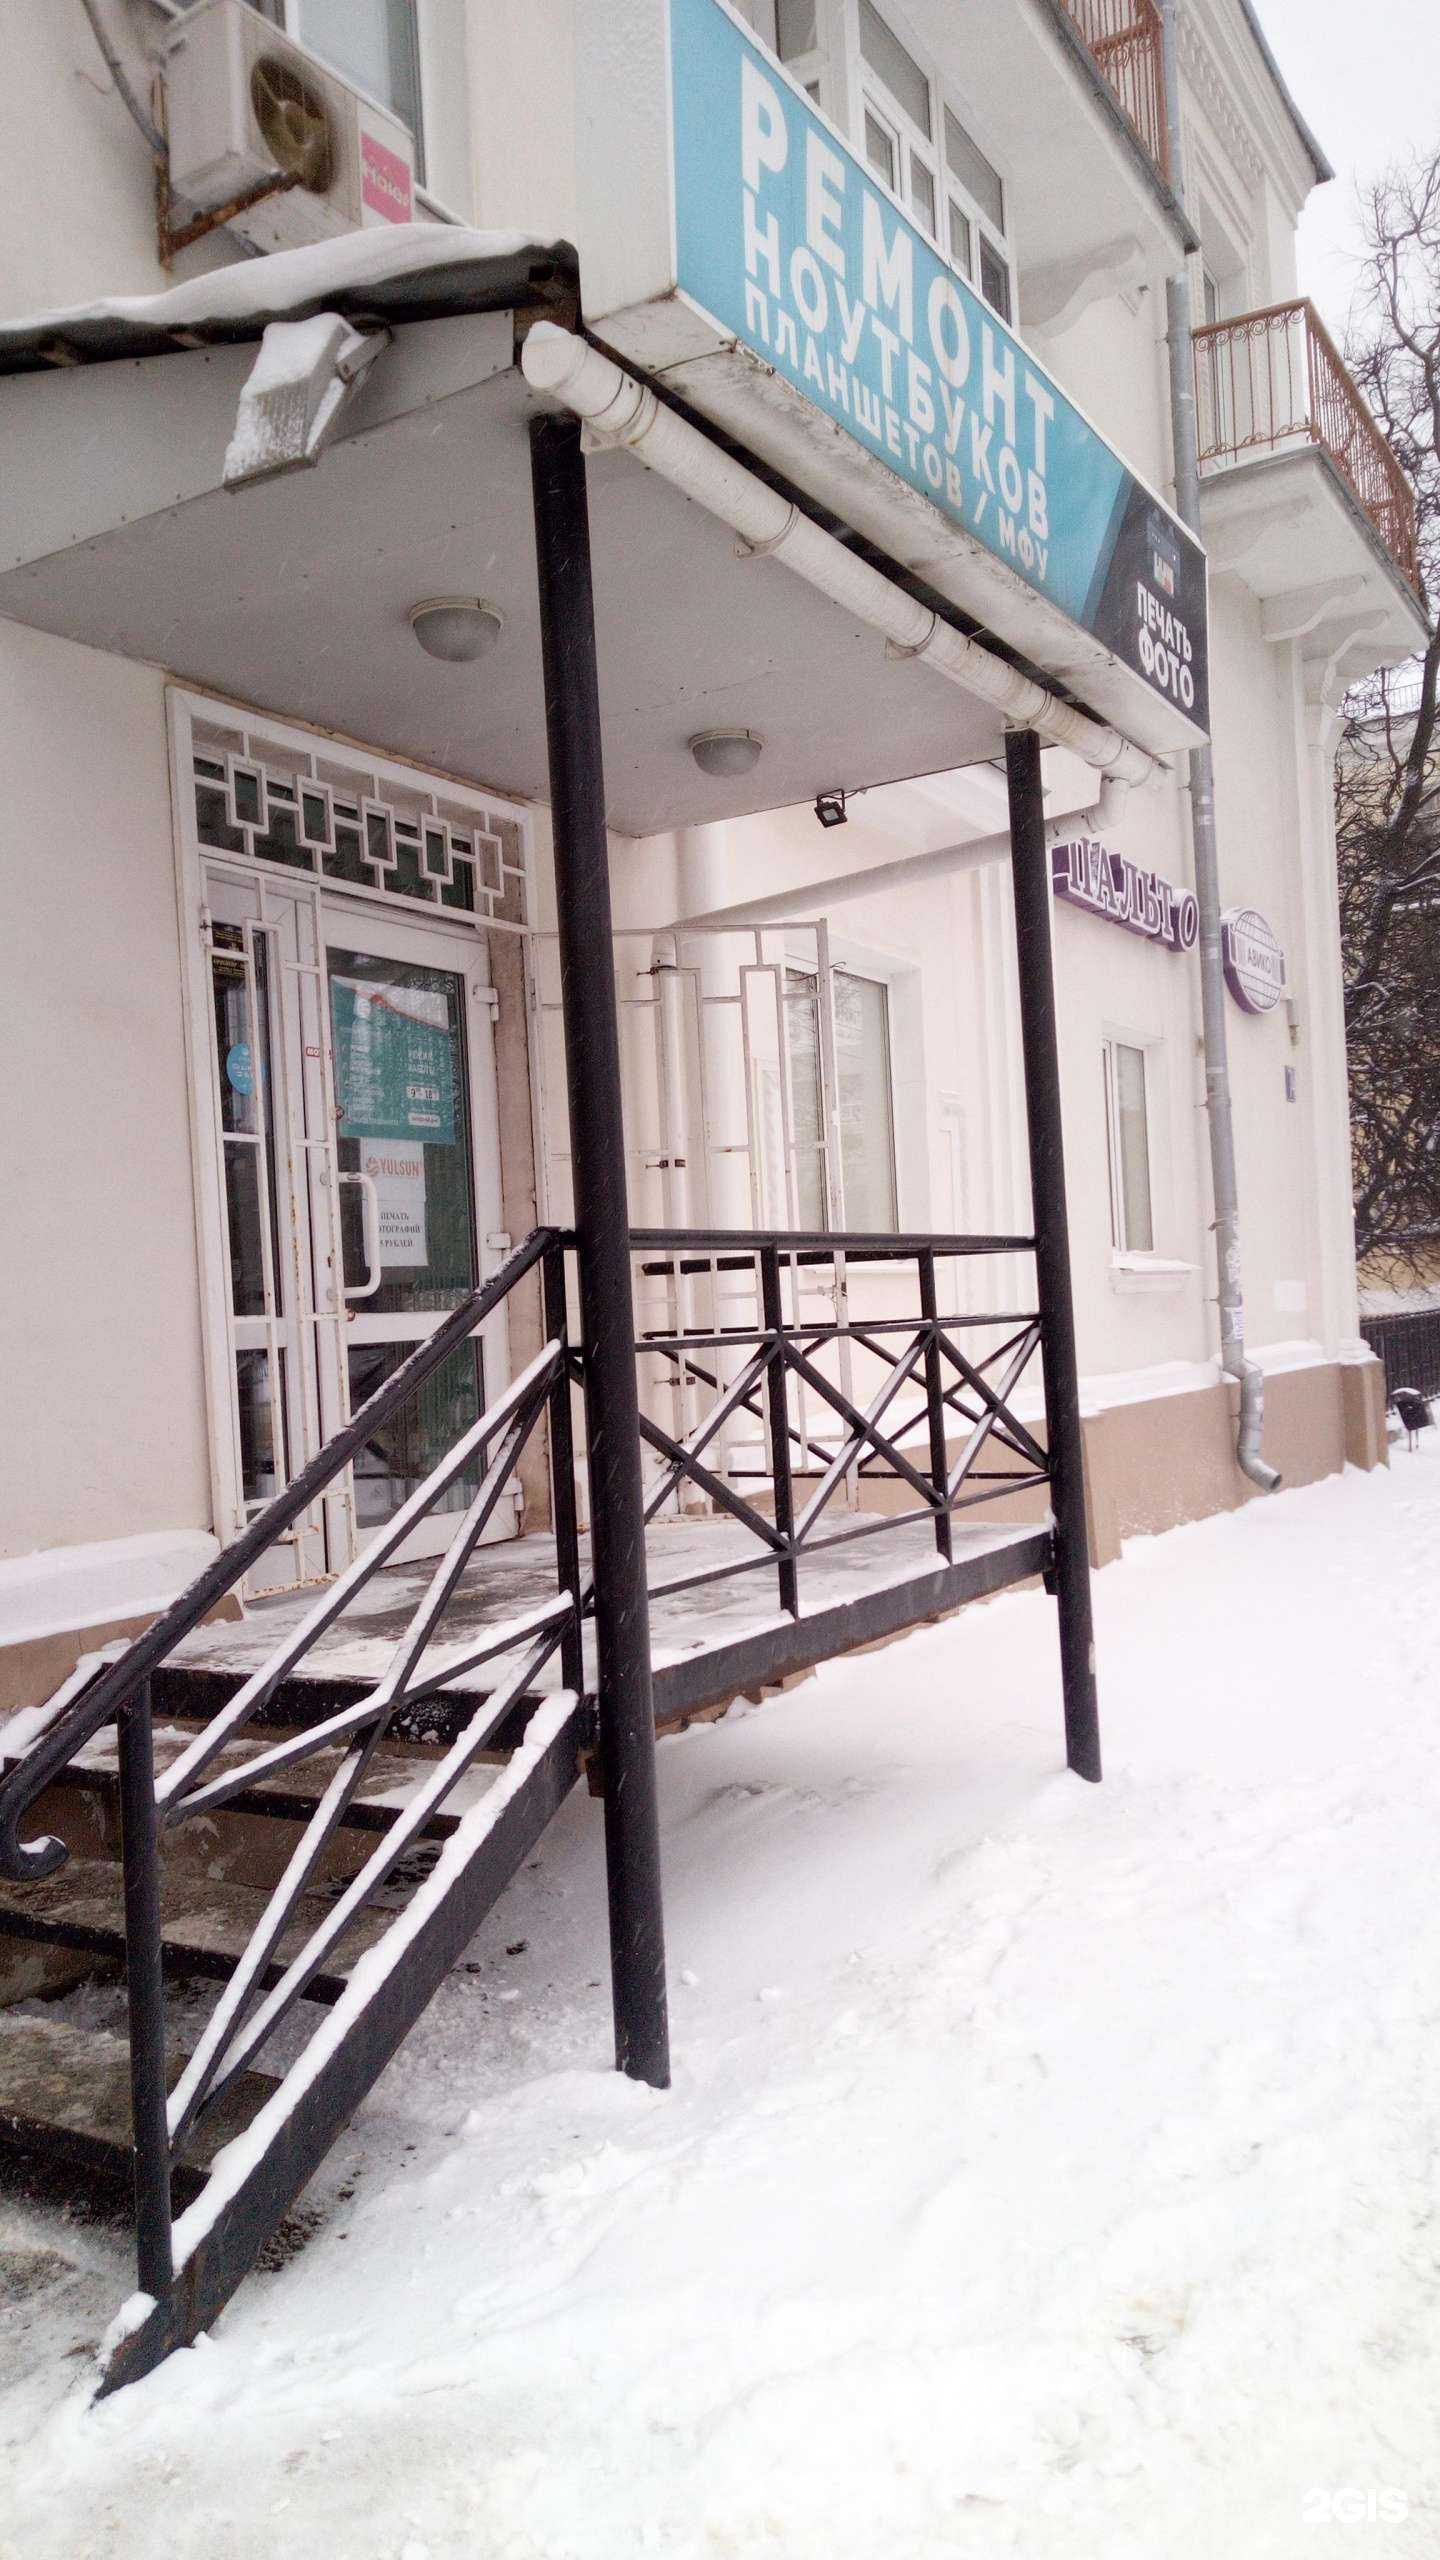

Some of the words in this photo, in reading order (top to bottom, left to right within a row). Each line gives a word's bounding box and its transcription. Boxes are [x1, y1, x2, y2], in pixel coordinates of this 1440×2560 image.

[741, 52, 1056, 479] РЕМОНТ
[744, 190, 1049, 542] НОУТБУКОВ
[744, 277, 963, 509] ПЛАНШЕТОВ
[999, 516, 1049, 582] МФУ
[1137, 581, 1193, 663] ПЕЧАТЬ
[1138, 622, 1195, 708] ФОТО
[1066, 837, 1198, 950] ПАЛЬТО
[380, 1158, 420, 1177] YULSUN
[378, 1224, 421, 1233] ТОГРАФИЙ
[380, 1211, 409, 1221] ПЕЧАТЬ
